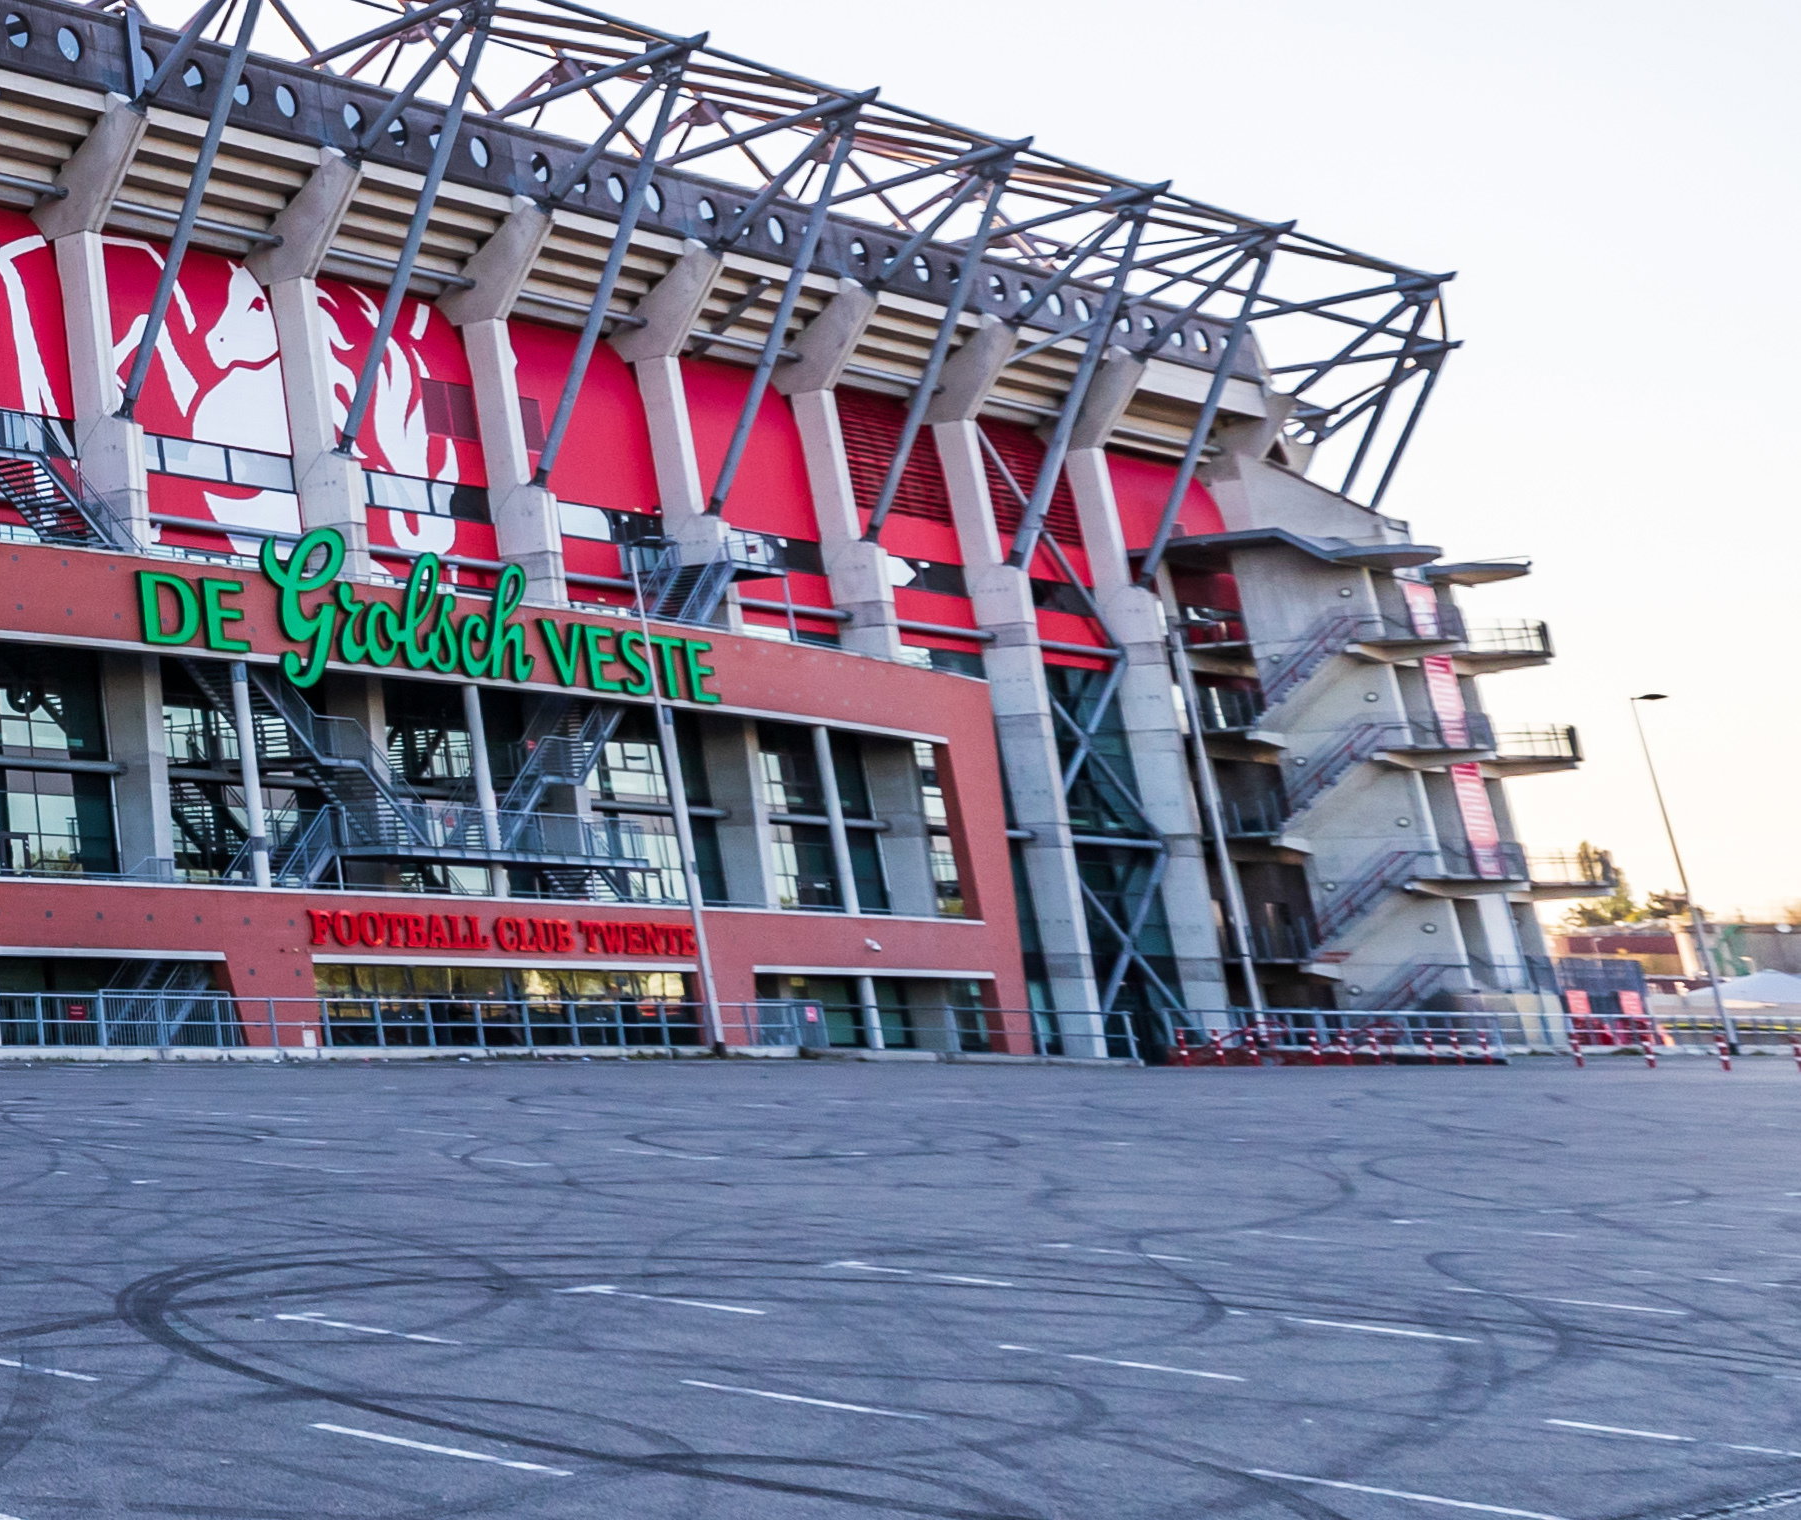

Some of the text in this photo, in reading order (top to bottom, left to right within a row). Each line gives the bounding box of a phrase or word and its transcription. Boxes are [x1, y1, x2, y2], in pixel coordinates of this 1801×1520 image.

[135, 526, 722, 705] DE Grolsch VESTE
[306, 908, 698, 957] FOOTBALL CLUB TWENTE
